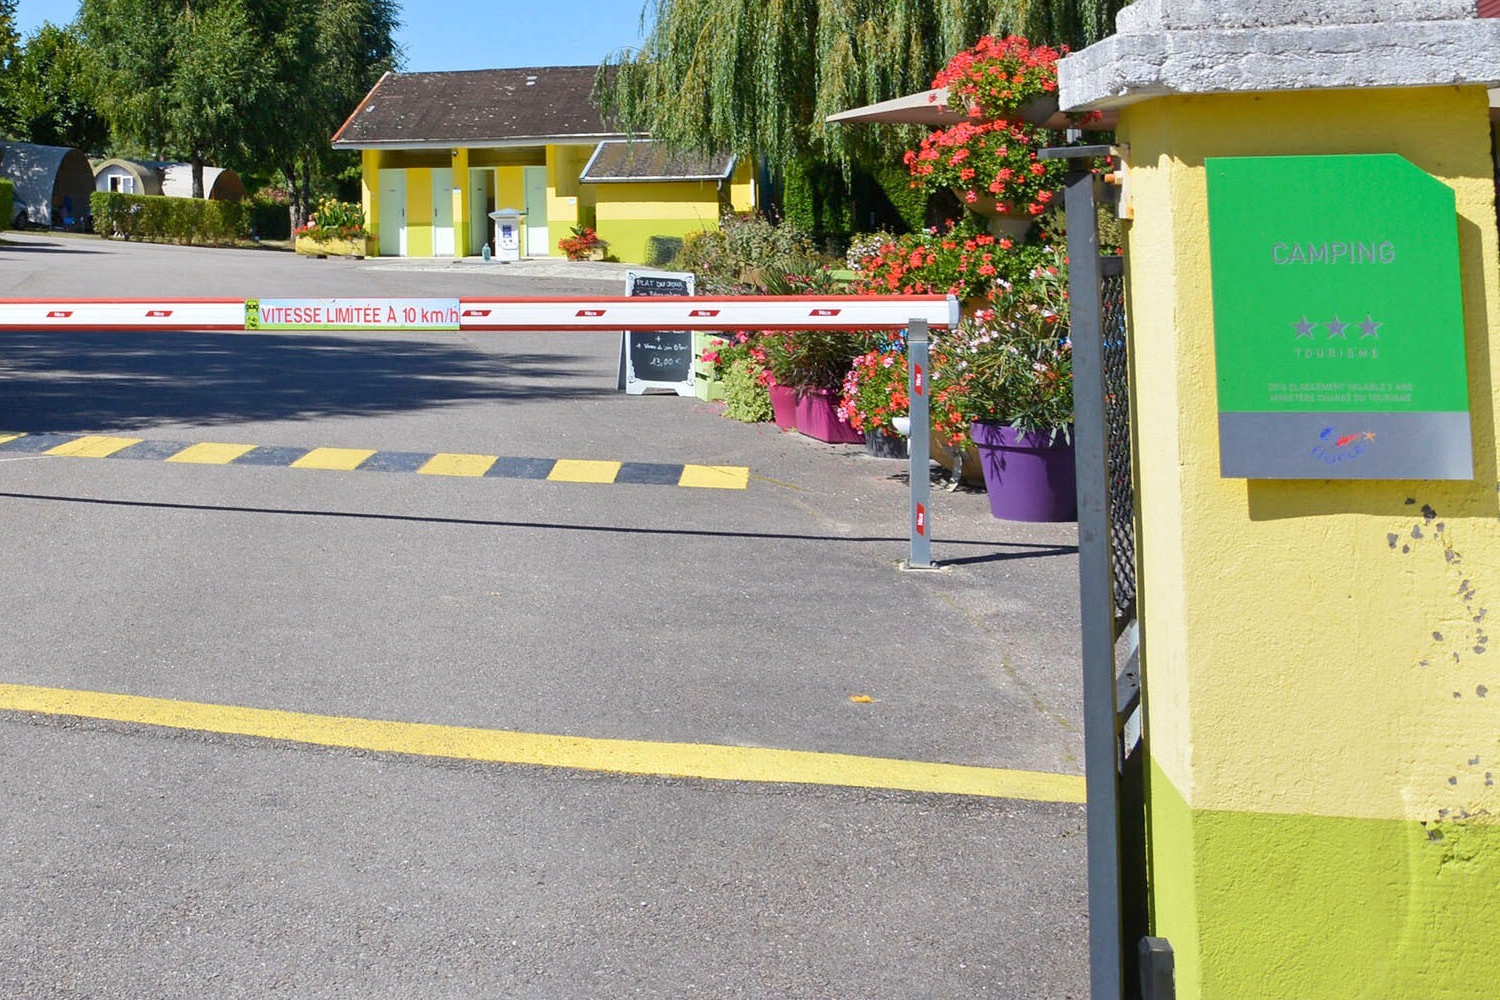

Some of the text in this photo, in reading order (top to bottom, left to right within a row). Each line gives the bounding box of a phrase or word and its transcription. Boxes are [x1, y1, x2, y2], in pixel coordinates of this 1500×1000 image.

[1271, 240, 1396, 265] CAMPING
[262, 307, 321, 324] VITESSE
[326, 304, 382, 324] LIMITÉE
[402, 307, 417, 324] 10
[421, 307, 460, 324] km/h
[1294, 347, 1380, 359] TOURISME
